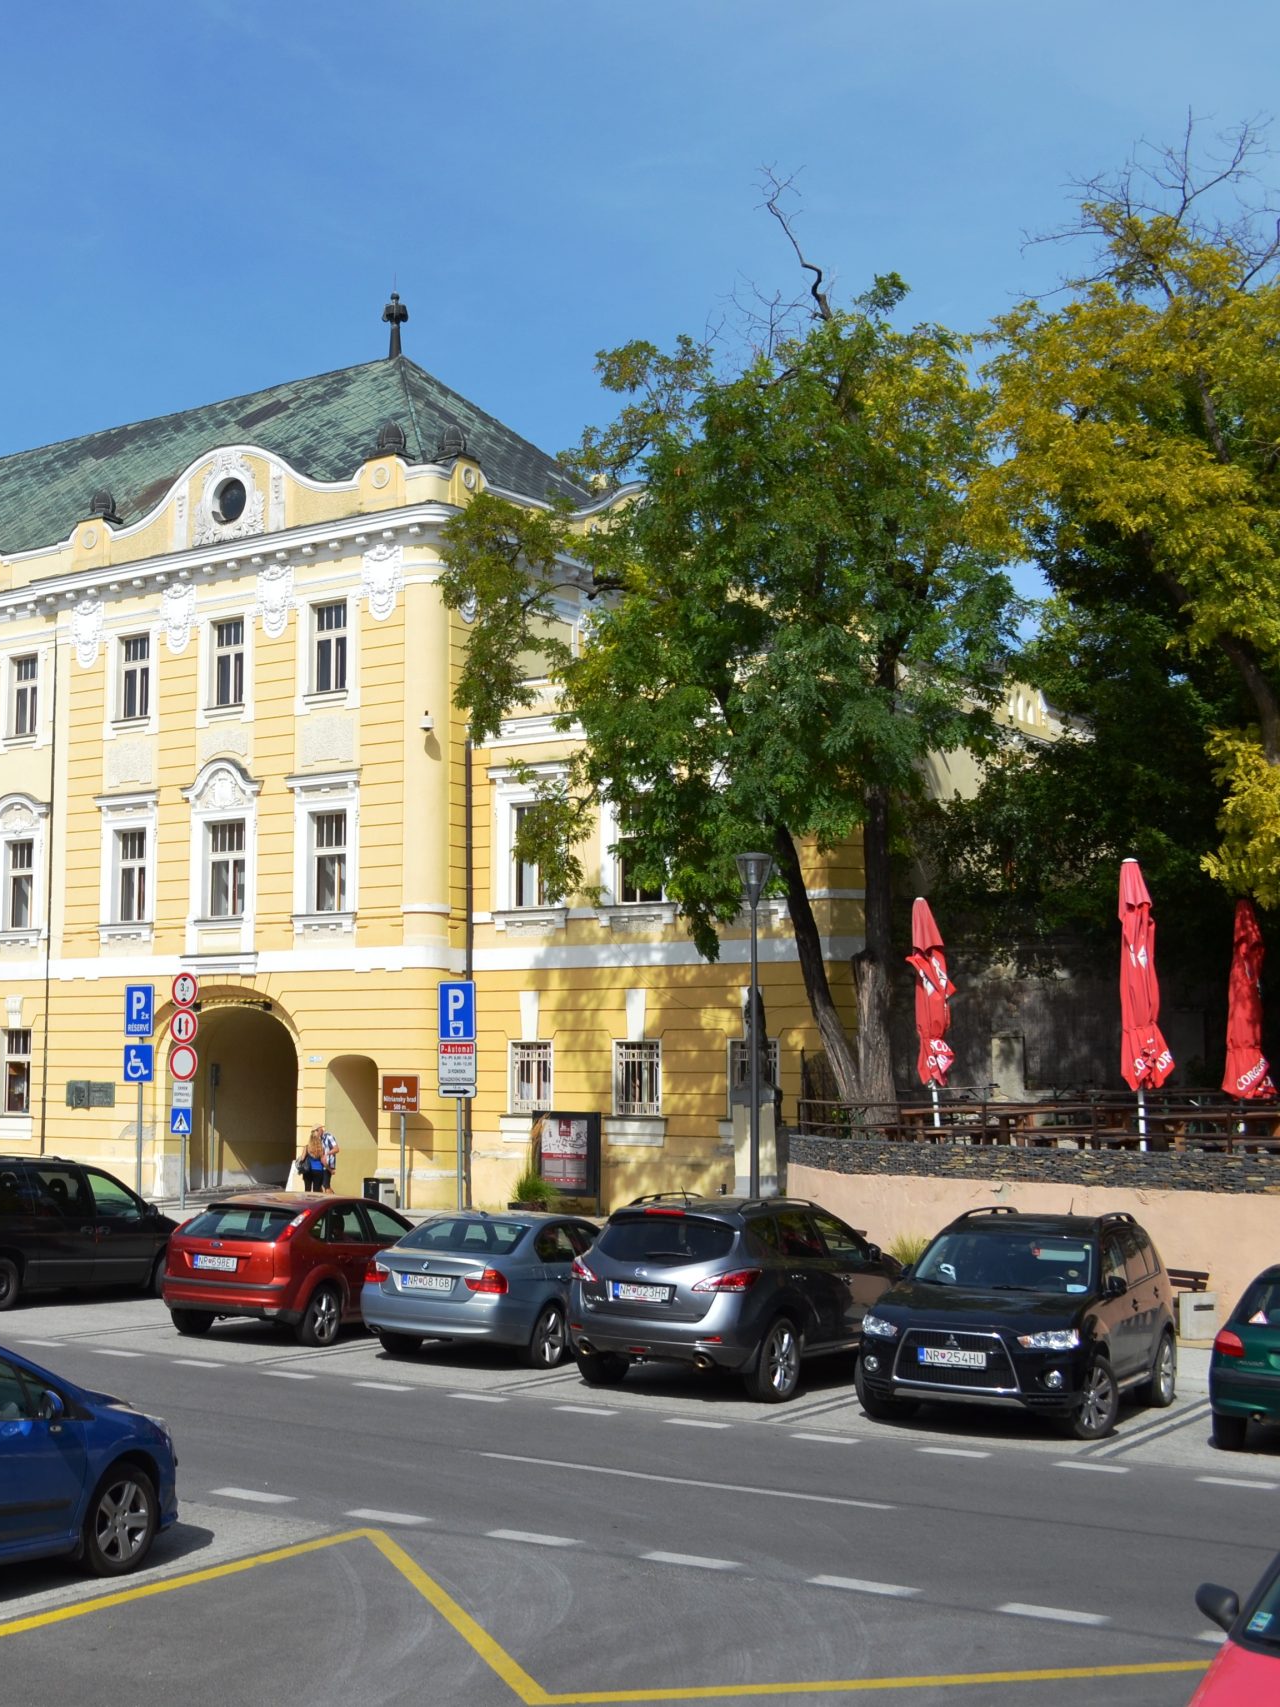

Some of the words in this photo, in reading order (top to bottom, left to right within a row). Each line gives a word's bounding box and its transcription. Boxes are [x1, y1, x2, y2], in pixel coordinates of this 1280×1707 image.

[132, 991, 146, 1020] P
[448, 989, 464, 1020] P
[440, 1045, 473, 1054] P-Automat
